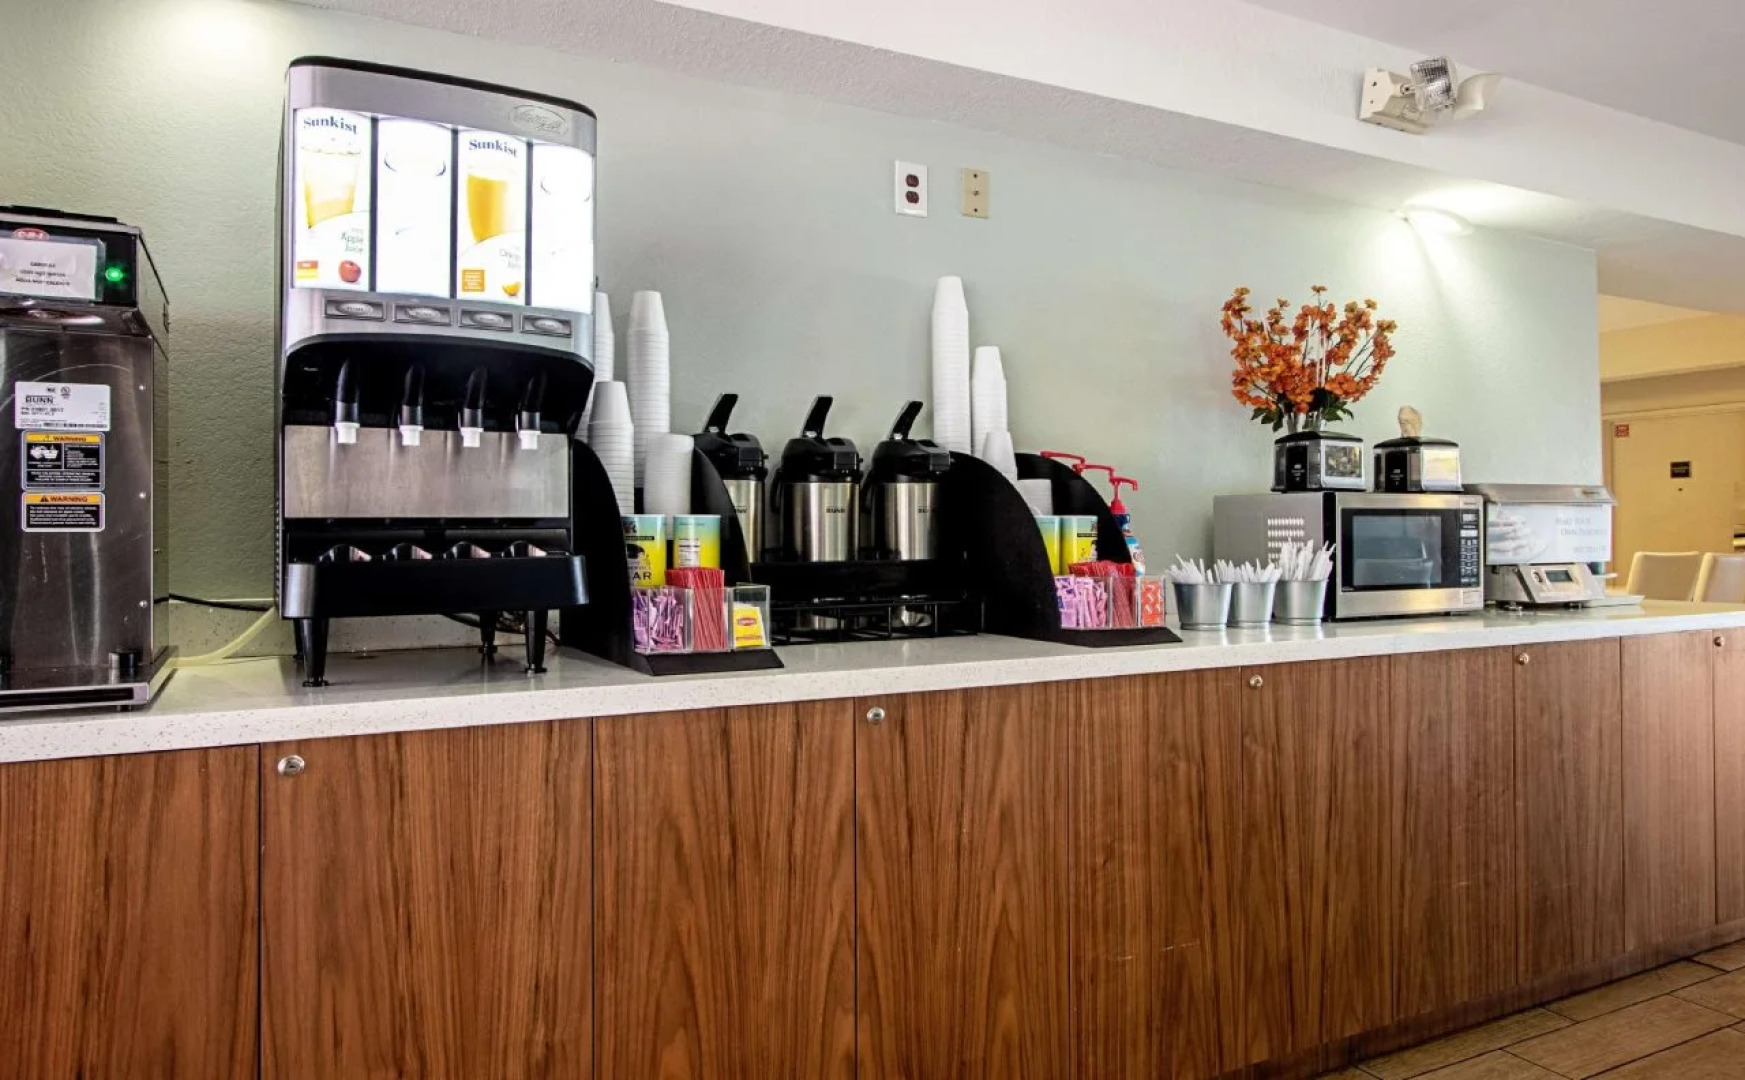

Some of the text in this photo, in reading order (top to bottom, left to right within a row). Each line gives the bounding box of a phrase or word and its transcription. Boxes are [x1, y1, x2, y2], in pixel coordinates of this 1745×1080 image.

[303, 116, 357, 135] Sunkist
[468, 139, 518, 158] Sunkist
[340, 231, 364, 243] Apple
[25, 395, 54, 404] BUNN
[50, 495, 88, 503] WARNING
